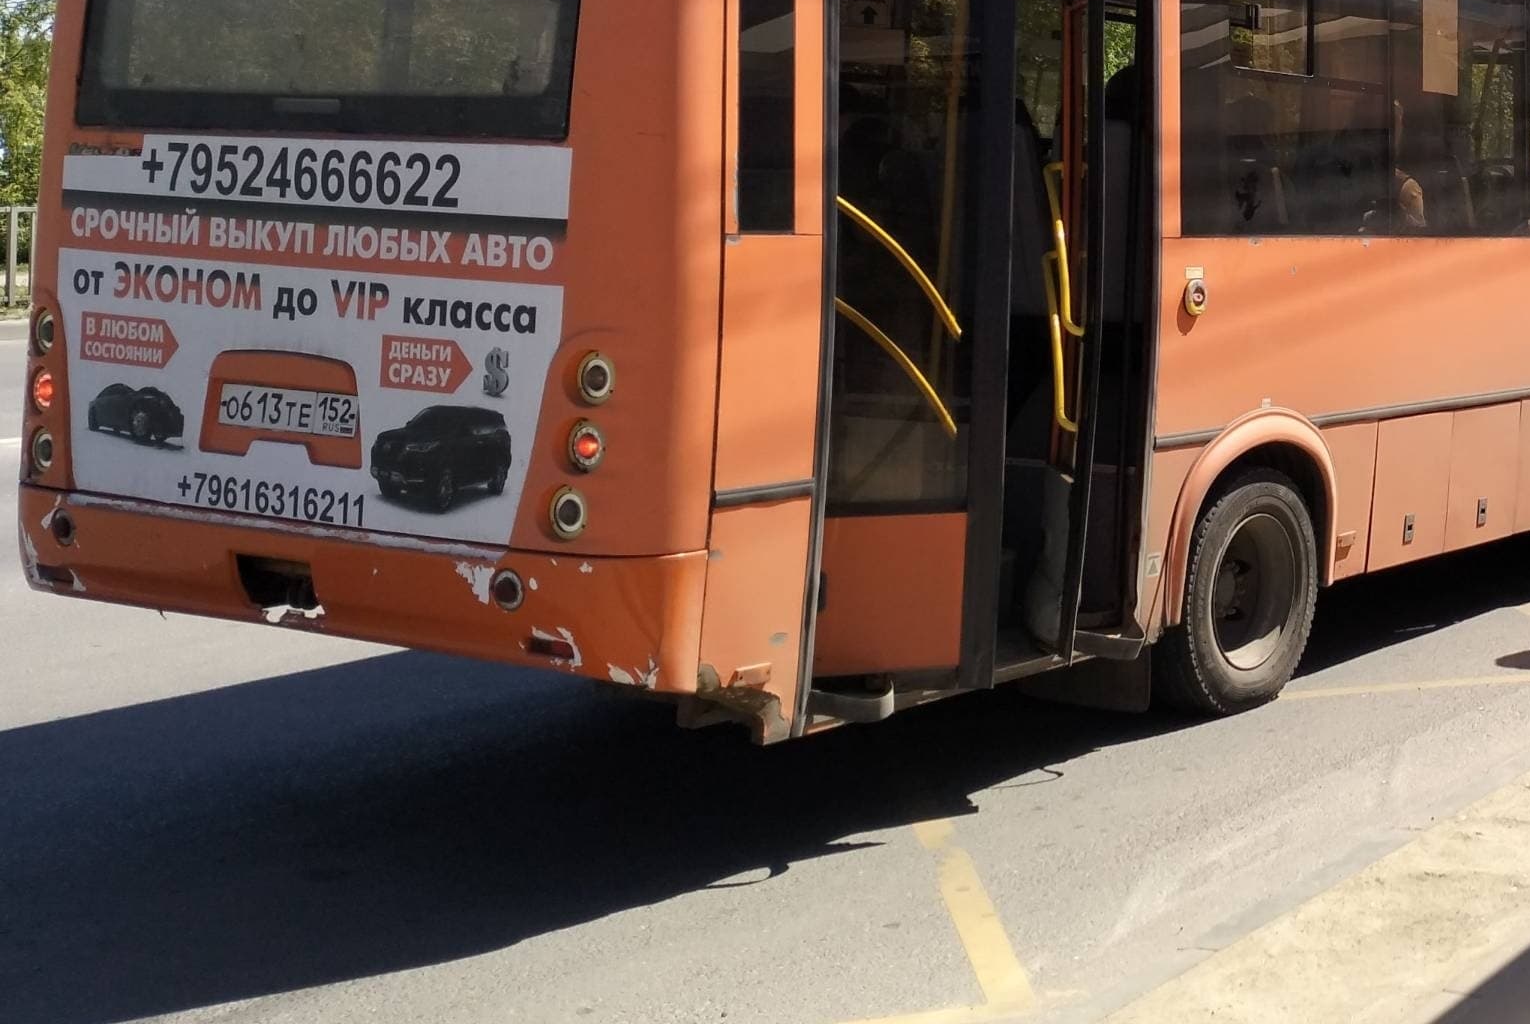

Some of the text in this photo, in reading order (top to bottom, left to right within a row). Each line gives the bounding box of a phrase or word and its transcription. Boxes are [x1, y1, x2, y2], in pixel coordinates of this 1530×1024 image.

[142, 142, 461, 207] +79524666622
[71, 206, 554, 271] СРОЧНЫЙ ВЫКУП ЛЮБЫХ АВТО
[73, 260, 538, 334] от ЭКОНОМ до VIP класса
[86, 317, 165, 343] В ЛЮБОМ
[84, 342, 163, 364] СОСТОЯНИИ
[388, 341, 452, 363] ДЕНЬГИ
[388, 365, 452, 388] СРАЗУ
[177, 472, 365, 526] +79616316211
